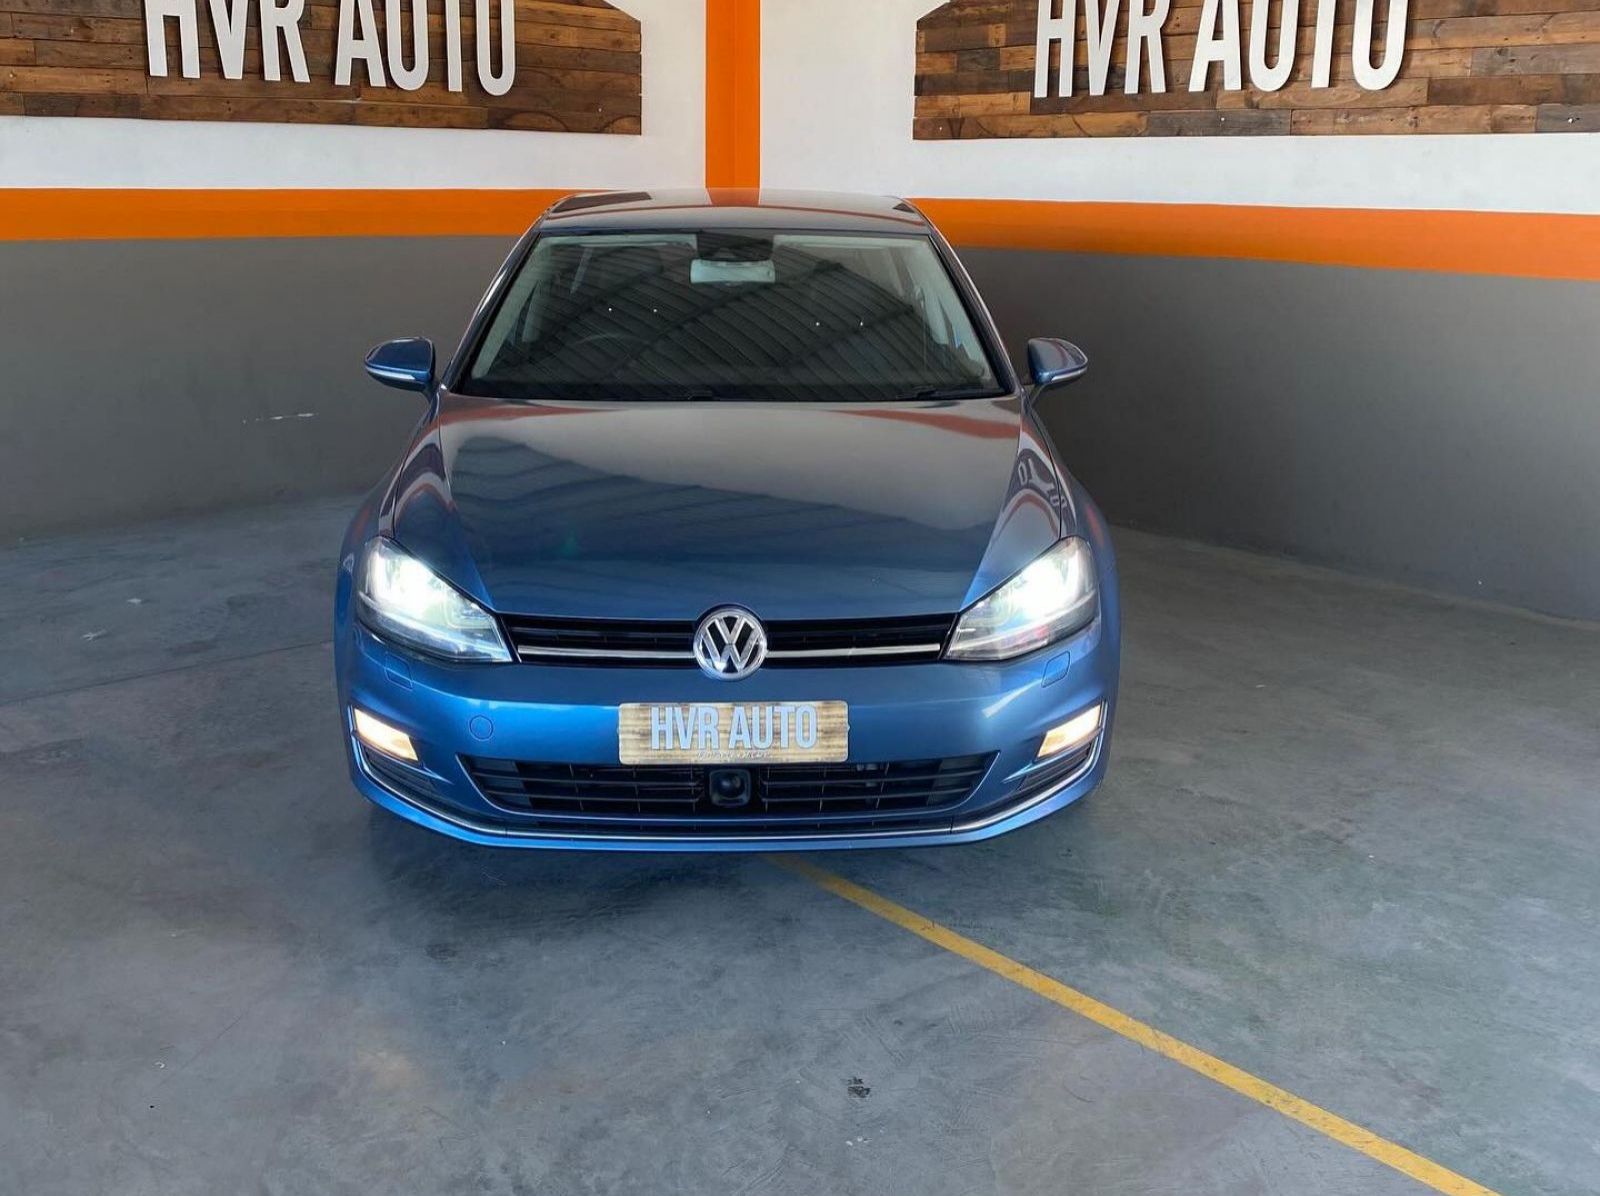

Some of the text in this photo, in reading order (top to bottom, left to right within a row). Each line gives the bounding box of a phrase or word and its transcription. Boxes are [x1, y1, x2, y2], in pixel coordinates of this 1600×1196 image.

[1033, 0, 1172, 98] HVR
[651, 704, 818, 750] HVR AUTO
